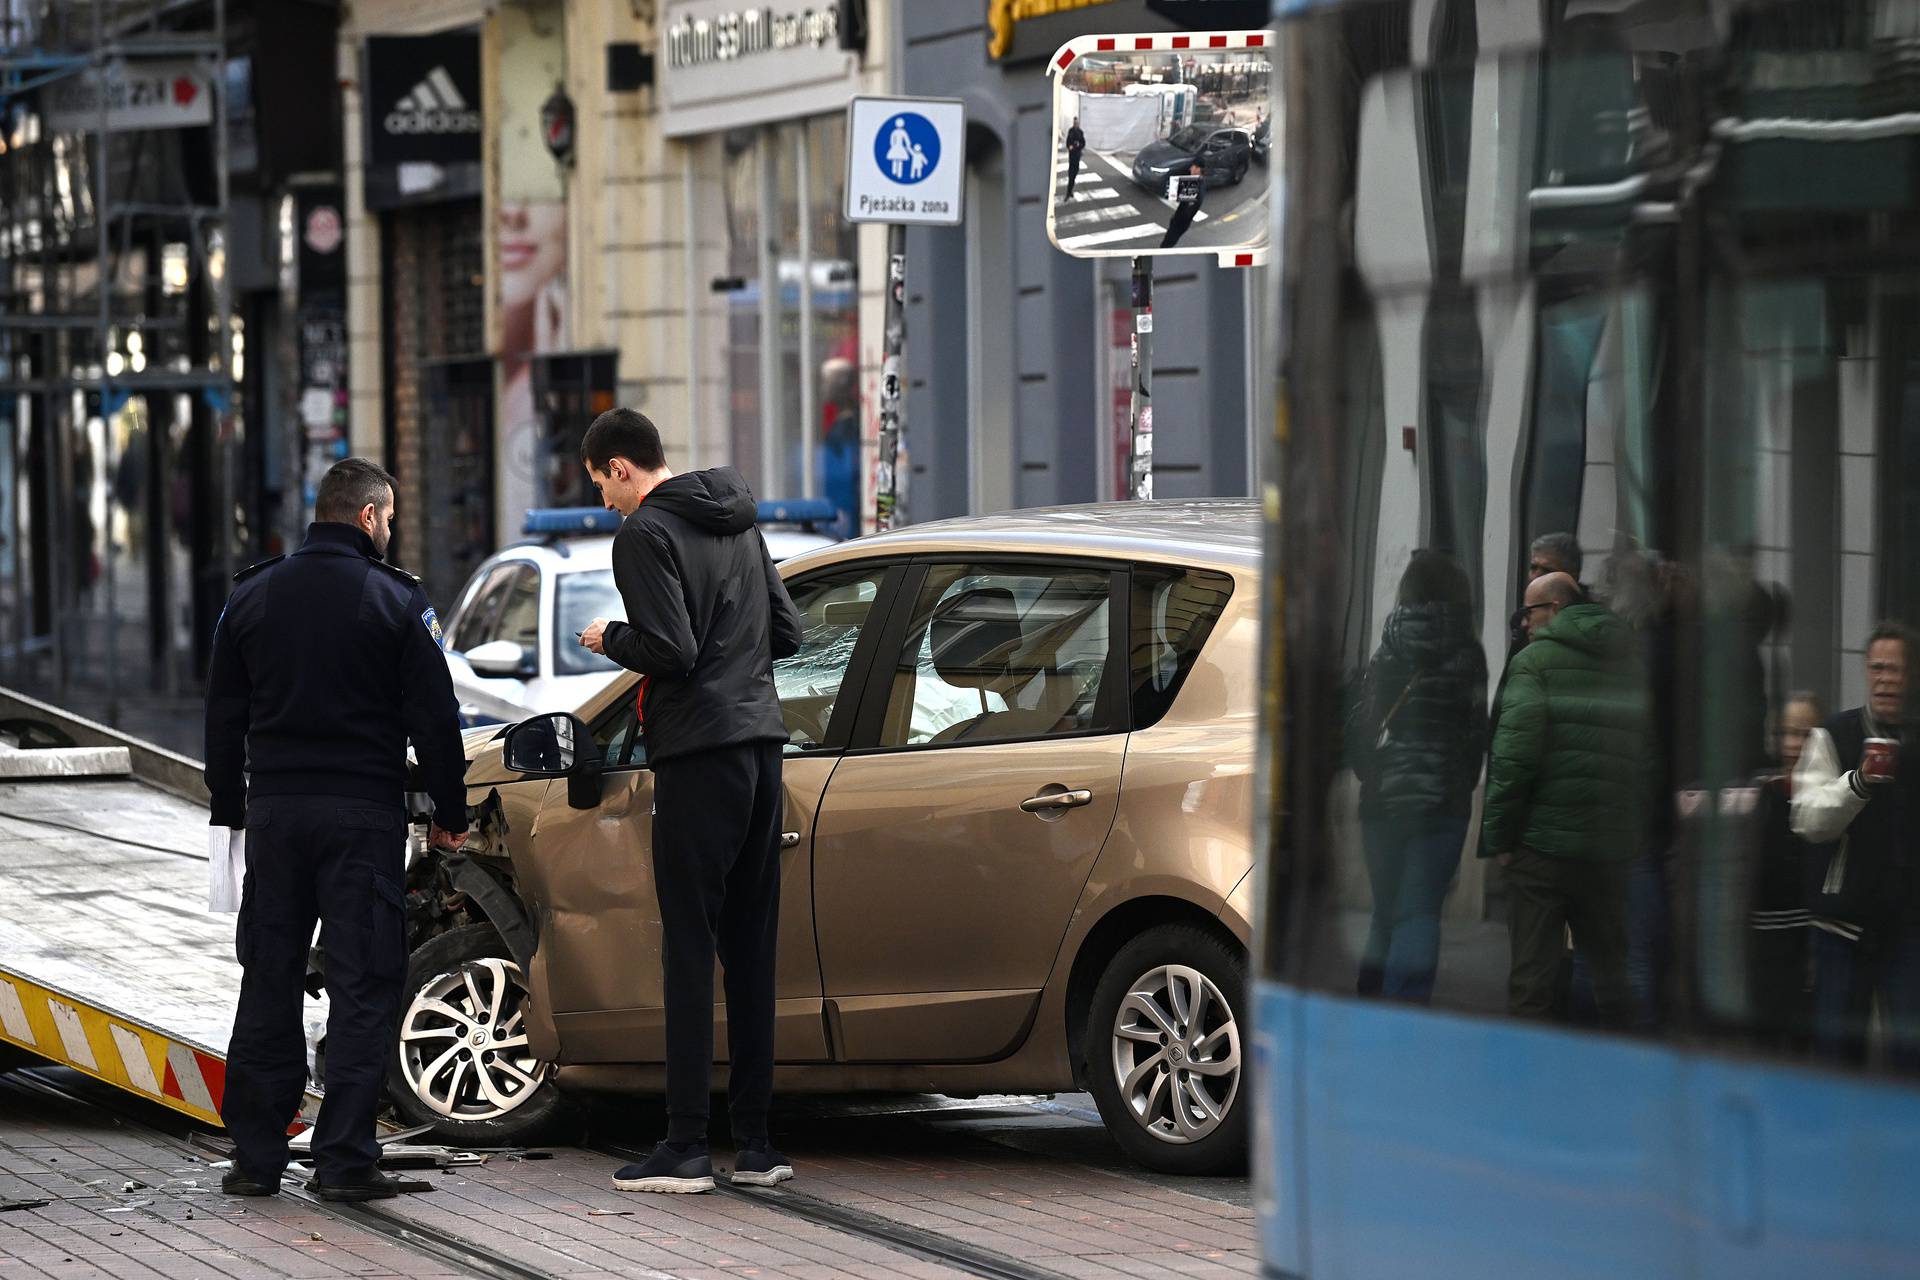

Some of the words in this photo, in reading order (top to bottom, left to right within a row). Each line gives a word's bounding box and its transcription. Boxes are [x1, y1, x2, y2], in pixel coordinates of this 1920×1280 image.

[384, 110, 481, 135] adidas
[860, 194, 916, 214] Pješačka
[921, 200, 949, 213] zona
